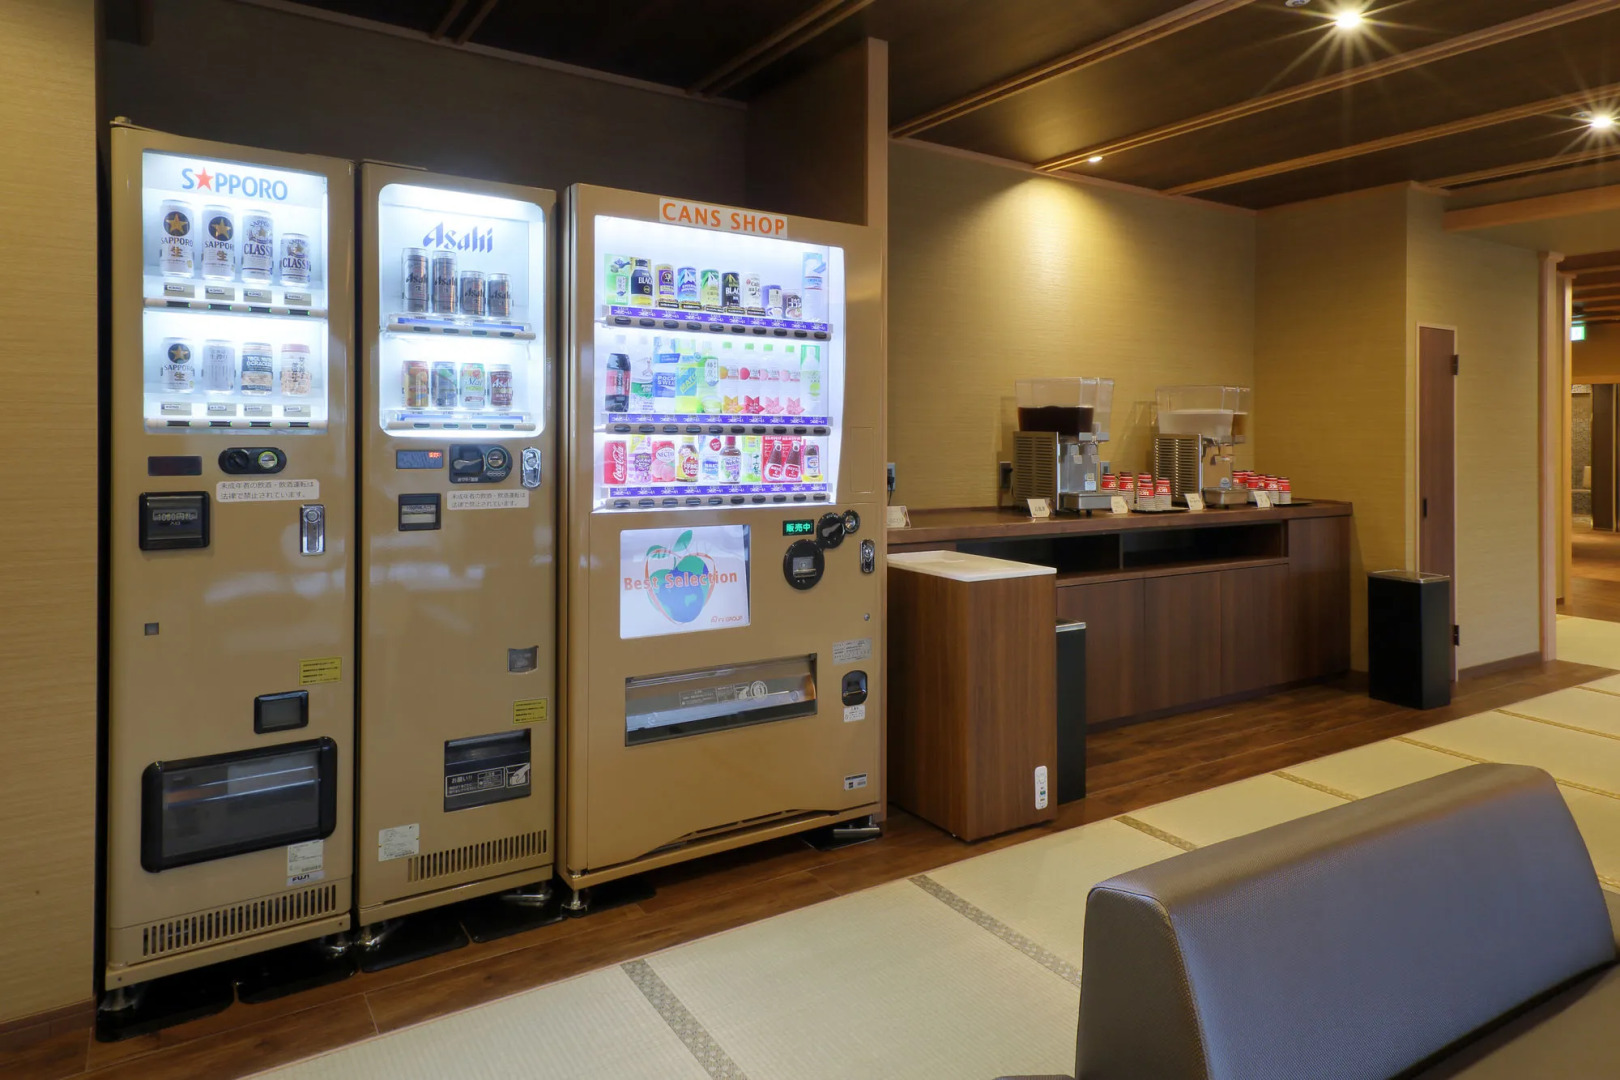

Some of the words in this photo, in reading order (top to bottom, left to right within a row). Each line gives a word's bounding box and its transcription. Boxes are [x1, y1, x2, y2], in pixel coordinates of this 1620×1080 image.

[662, 202, 721, 228] CANS
[730, 212, 785, 235] SHOP
[422, 221, 493, 254] Asahi
[785, 522, 811, 533] 販売中
[623, 577, 659, 591] Best
[664, 571, 738, 589] Selection
